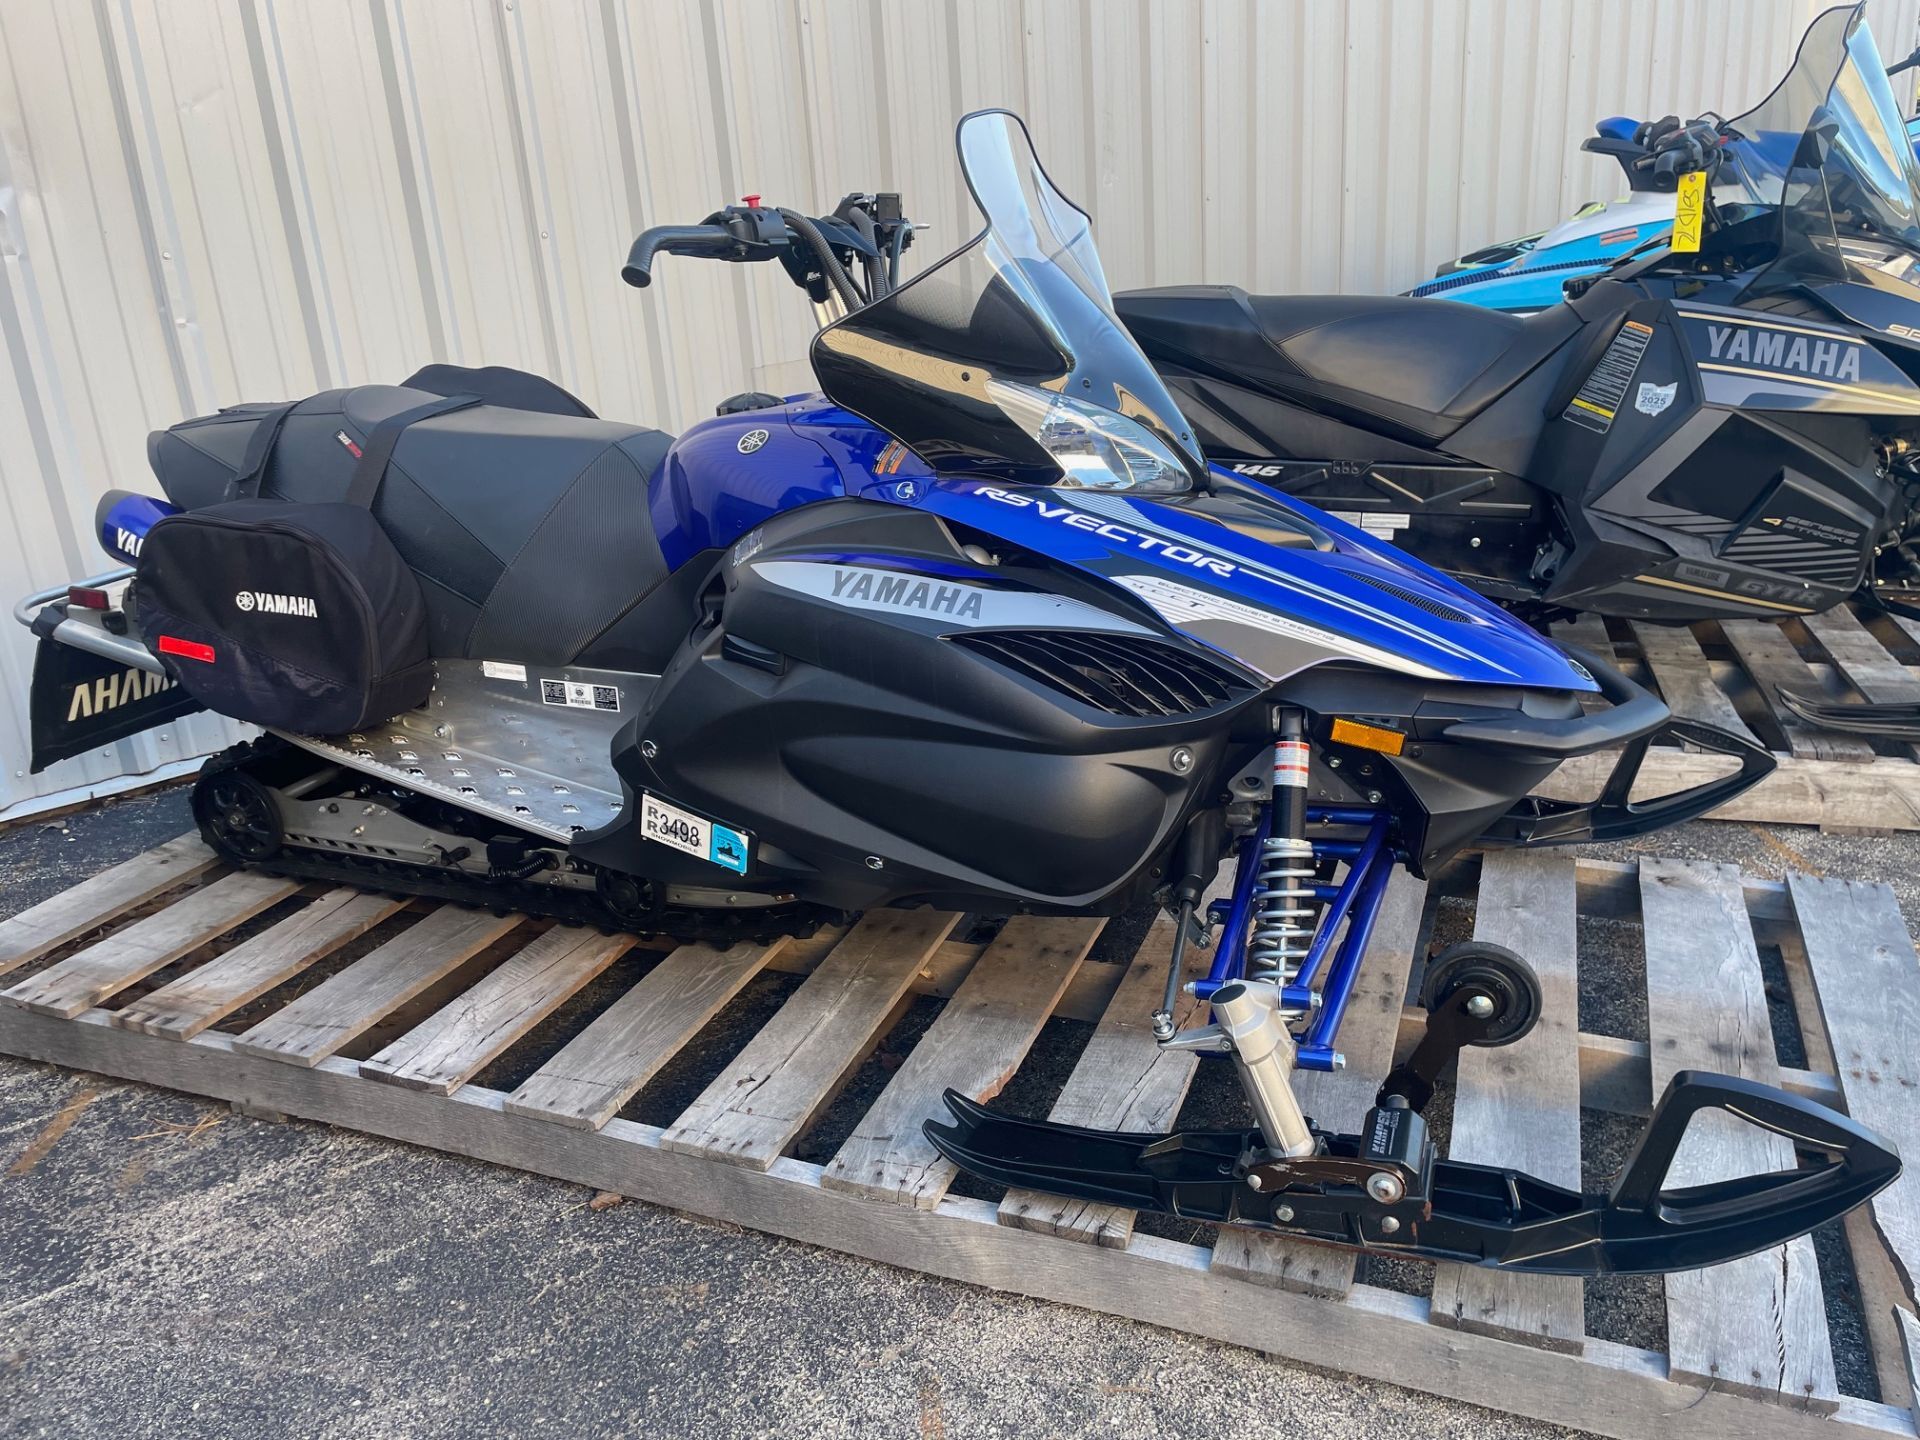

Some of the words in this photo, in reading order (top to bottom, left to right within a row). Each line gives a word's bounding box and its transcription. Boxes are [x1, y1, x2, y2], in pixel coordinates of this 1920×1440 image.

[1707, 325, 1860, 383] YAMAHA
[1641, 396, 1667, 405] 2025
[1232, 463, 1284, 477] 146
[254, 591, 318, 618] YAMAHA
[831, 569, 984, 621] YAMAHA
[660, 813, 701, 848] 3498
